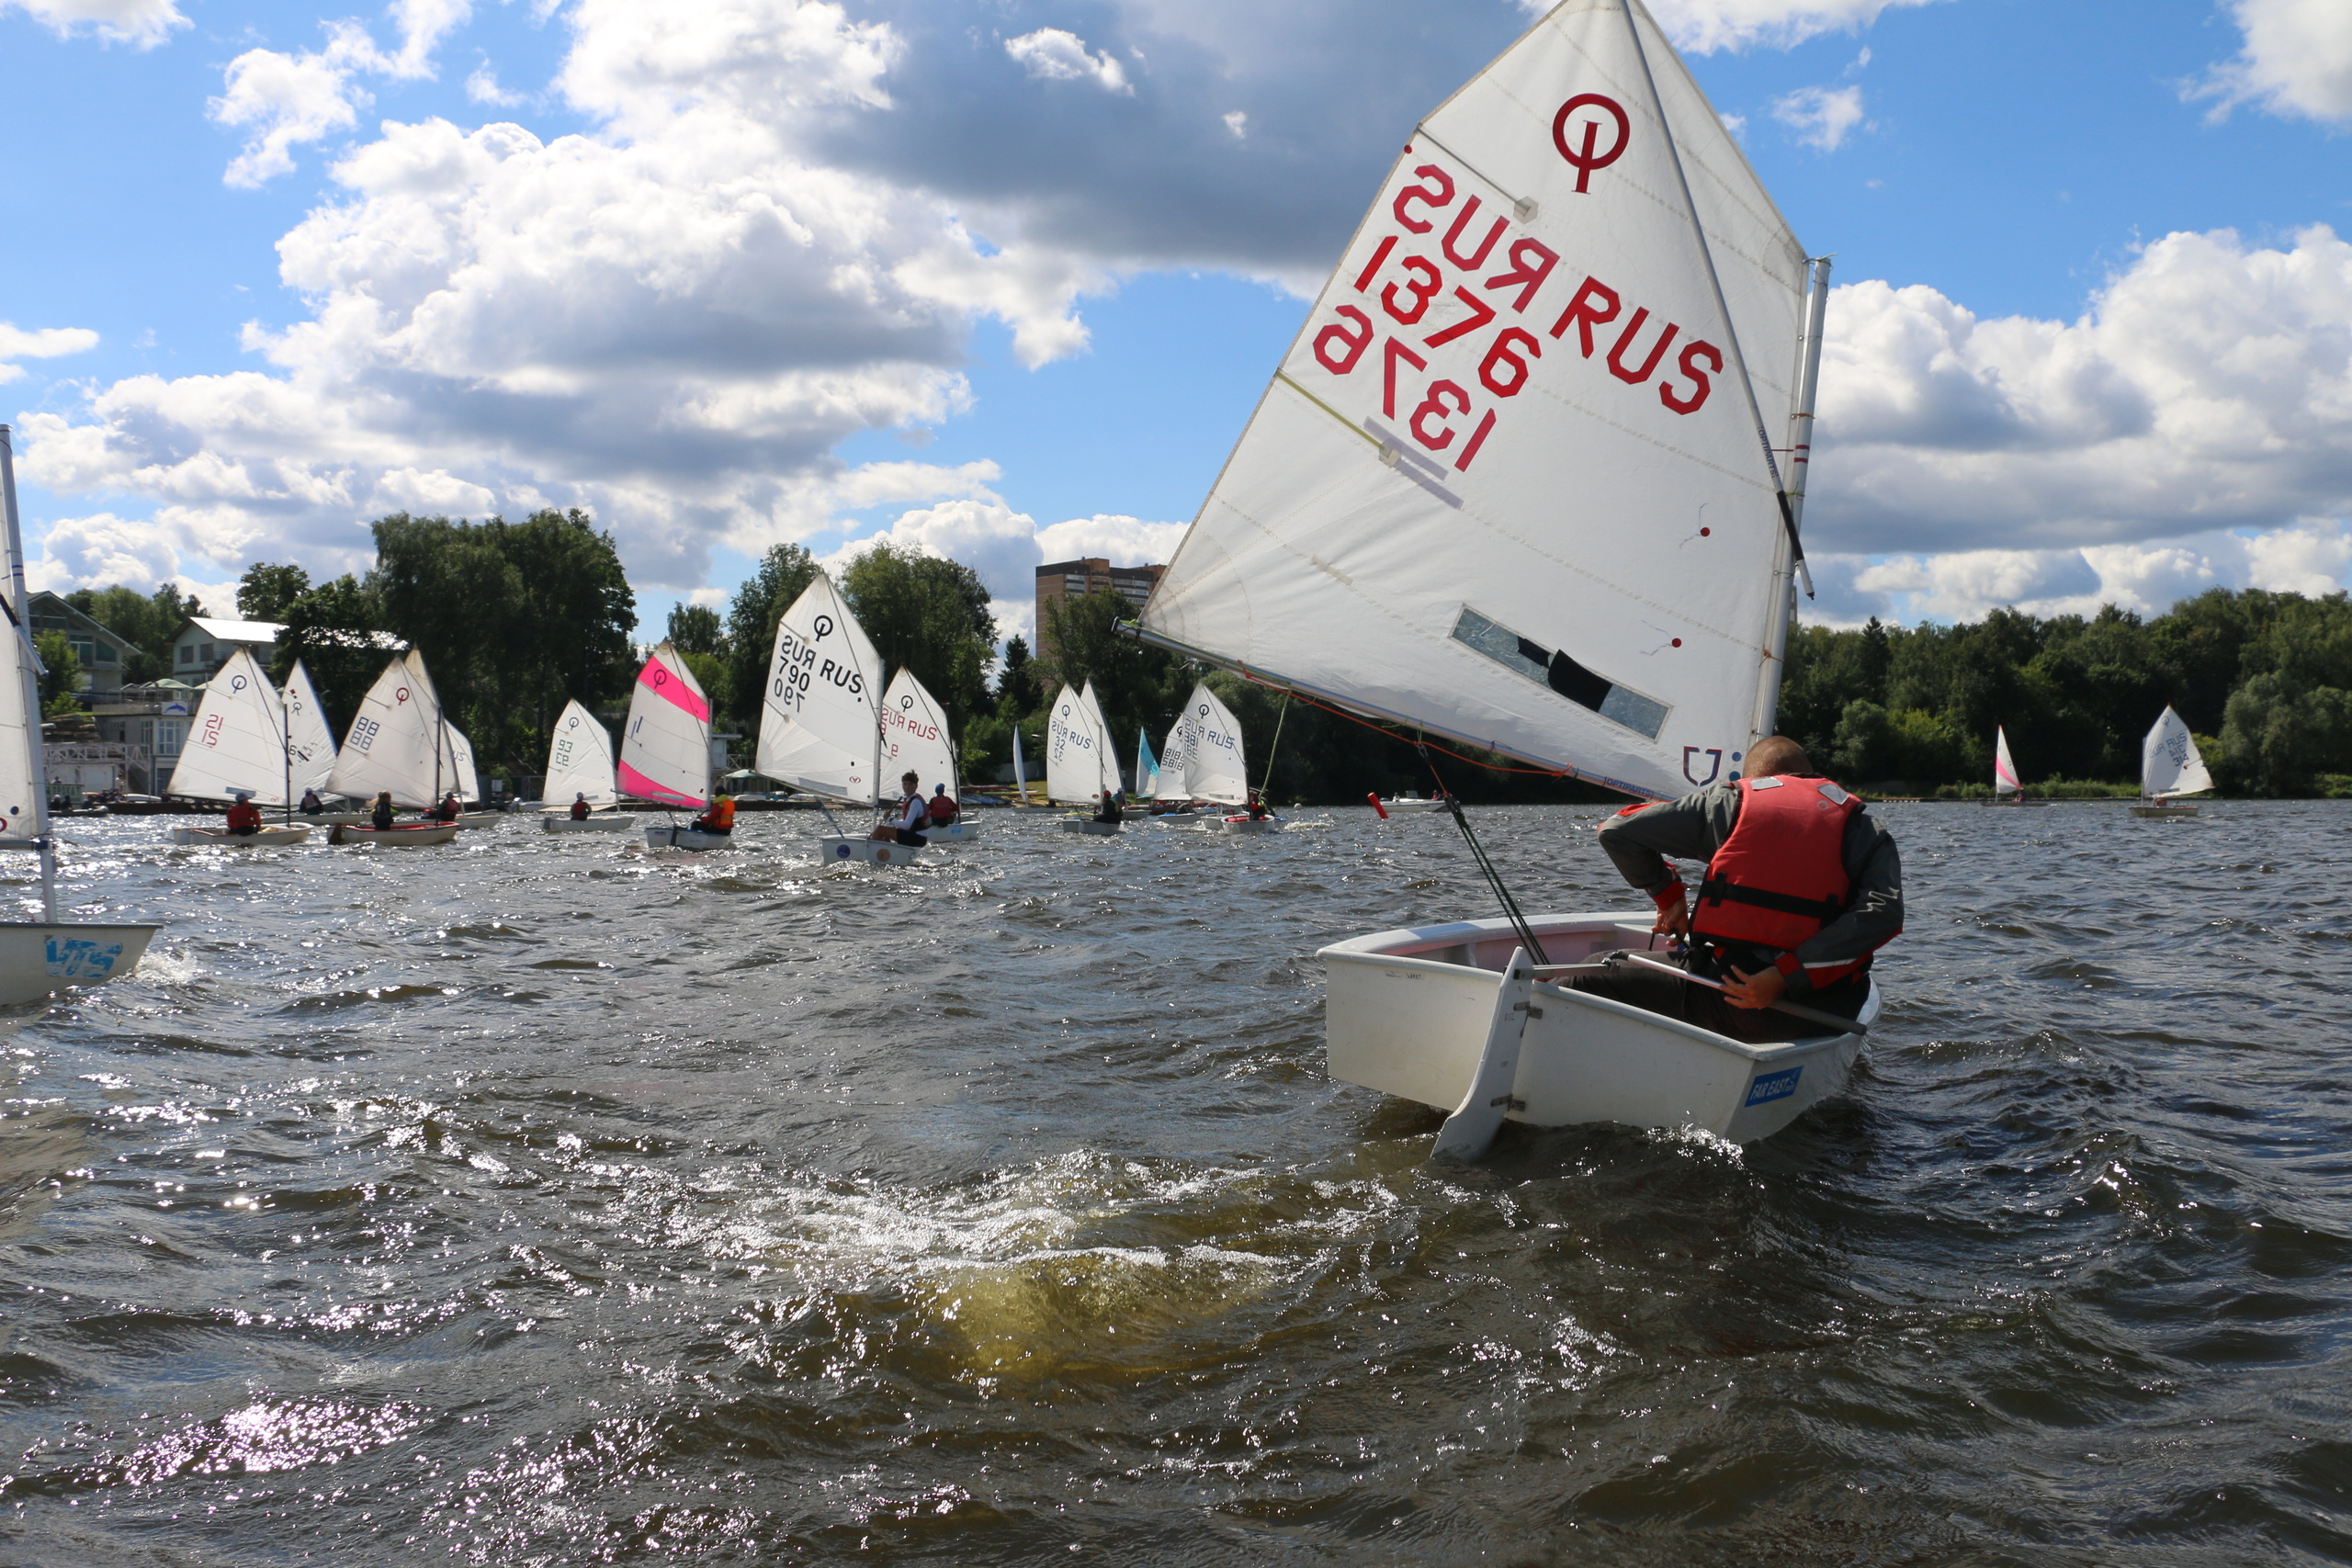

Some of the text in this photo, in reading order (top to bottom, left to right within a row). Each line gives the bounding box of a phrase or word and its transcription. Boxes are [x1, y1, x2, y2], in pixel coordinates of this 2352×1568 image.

[1353, 235, 1542, 399] 1376
[1549, 276, 1724, 415] RUS
[1758, 428, 1779, 476] OPTIPARTS
[779, 656, 809, 692] 790
[820, 659, 863, 694] RUS
[356, 716, 380, 736] 88
[908, 720, 937, 740] RUS
[558, 739, 573, 753] 93
[1055, 736, 1066, 751] 32
[1069, 731, 1091, 750] RUS
[1207, 730, 1236, 750] RUS
[2166, 732, 2188, 748] RUS
[2173, 752, 2190, 767] 314
[1607, 778, 1652, 797] OPTIPARTS
[1749, 1077, 1791, 1100] FAR EAST
